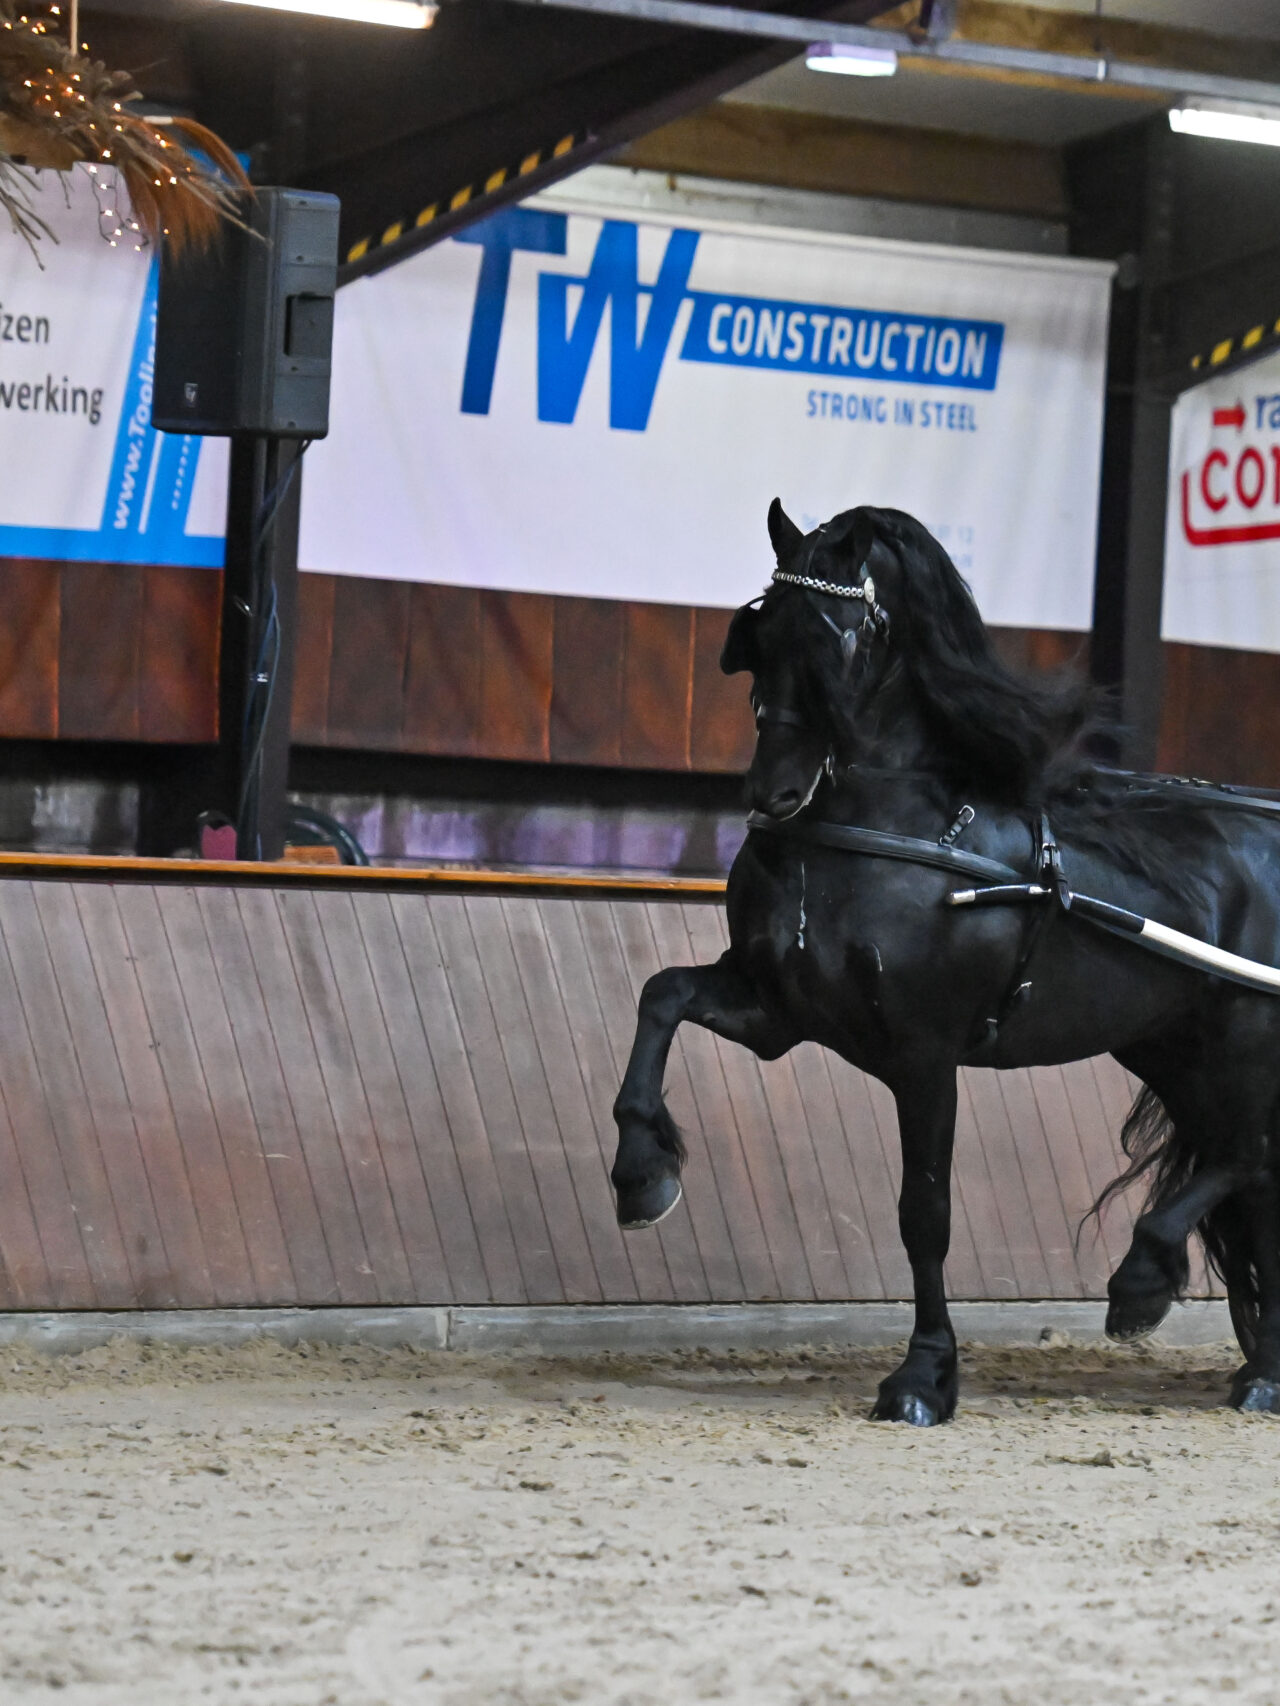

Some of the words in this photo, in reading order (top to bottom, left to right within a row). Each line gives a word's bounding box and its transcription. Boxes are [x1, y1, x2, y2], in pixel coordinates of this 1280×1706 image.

[0, 302, 50, 344] zen
[450, 207, 702, 432] TW
[707, 303, 988, 379] CONSTRUCTION
[806, 389, 887, 424] STRONG
[893, 399, 914, 427] IN
[919, 401, 978, 432] STEEL
